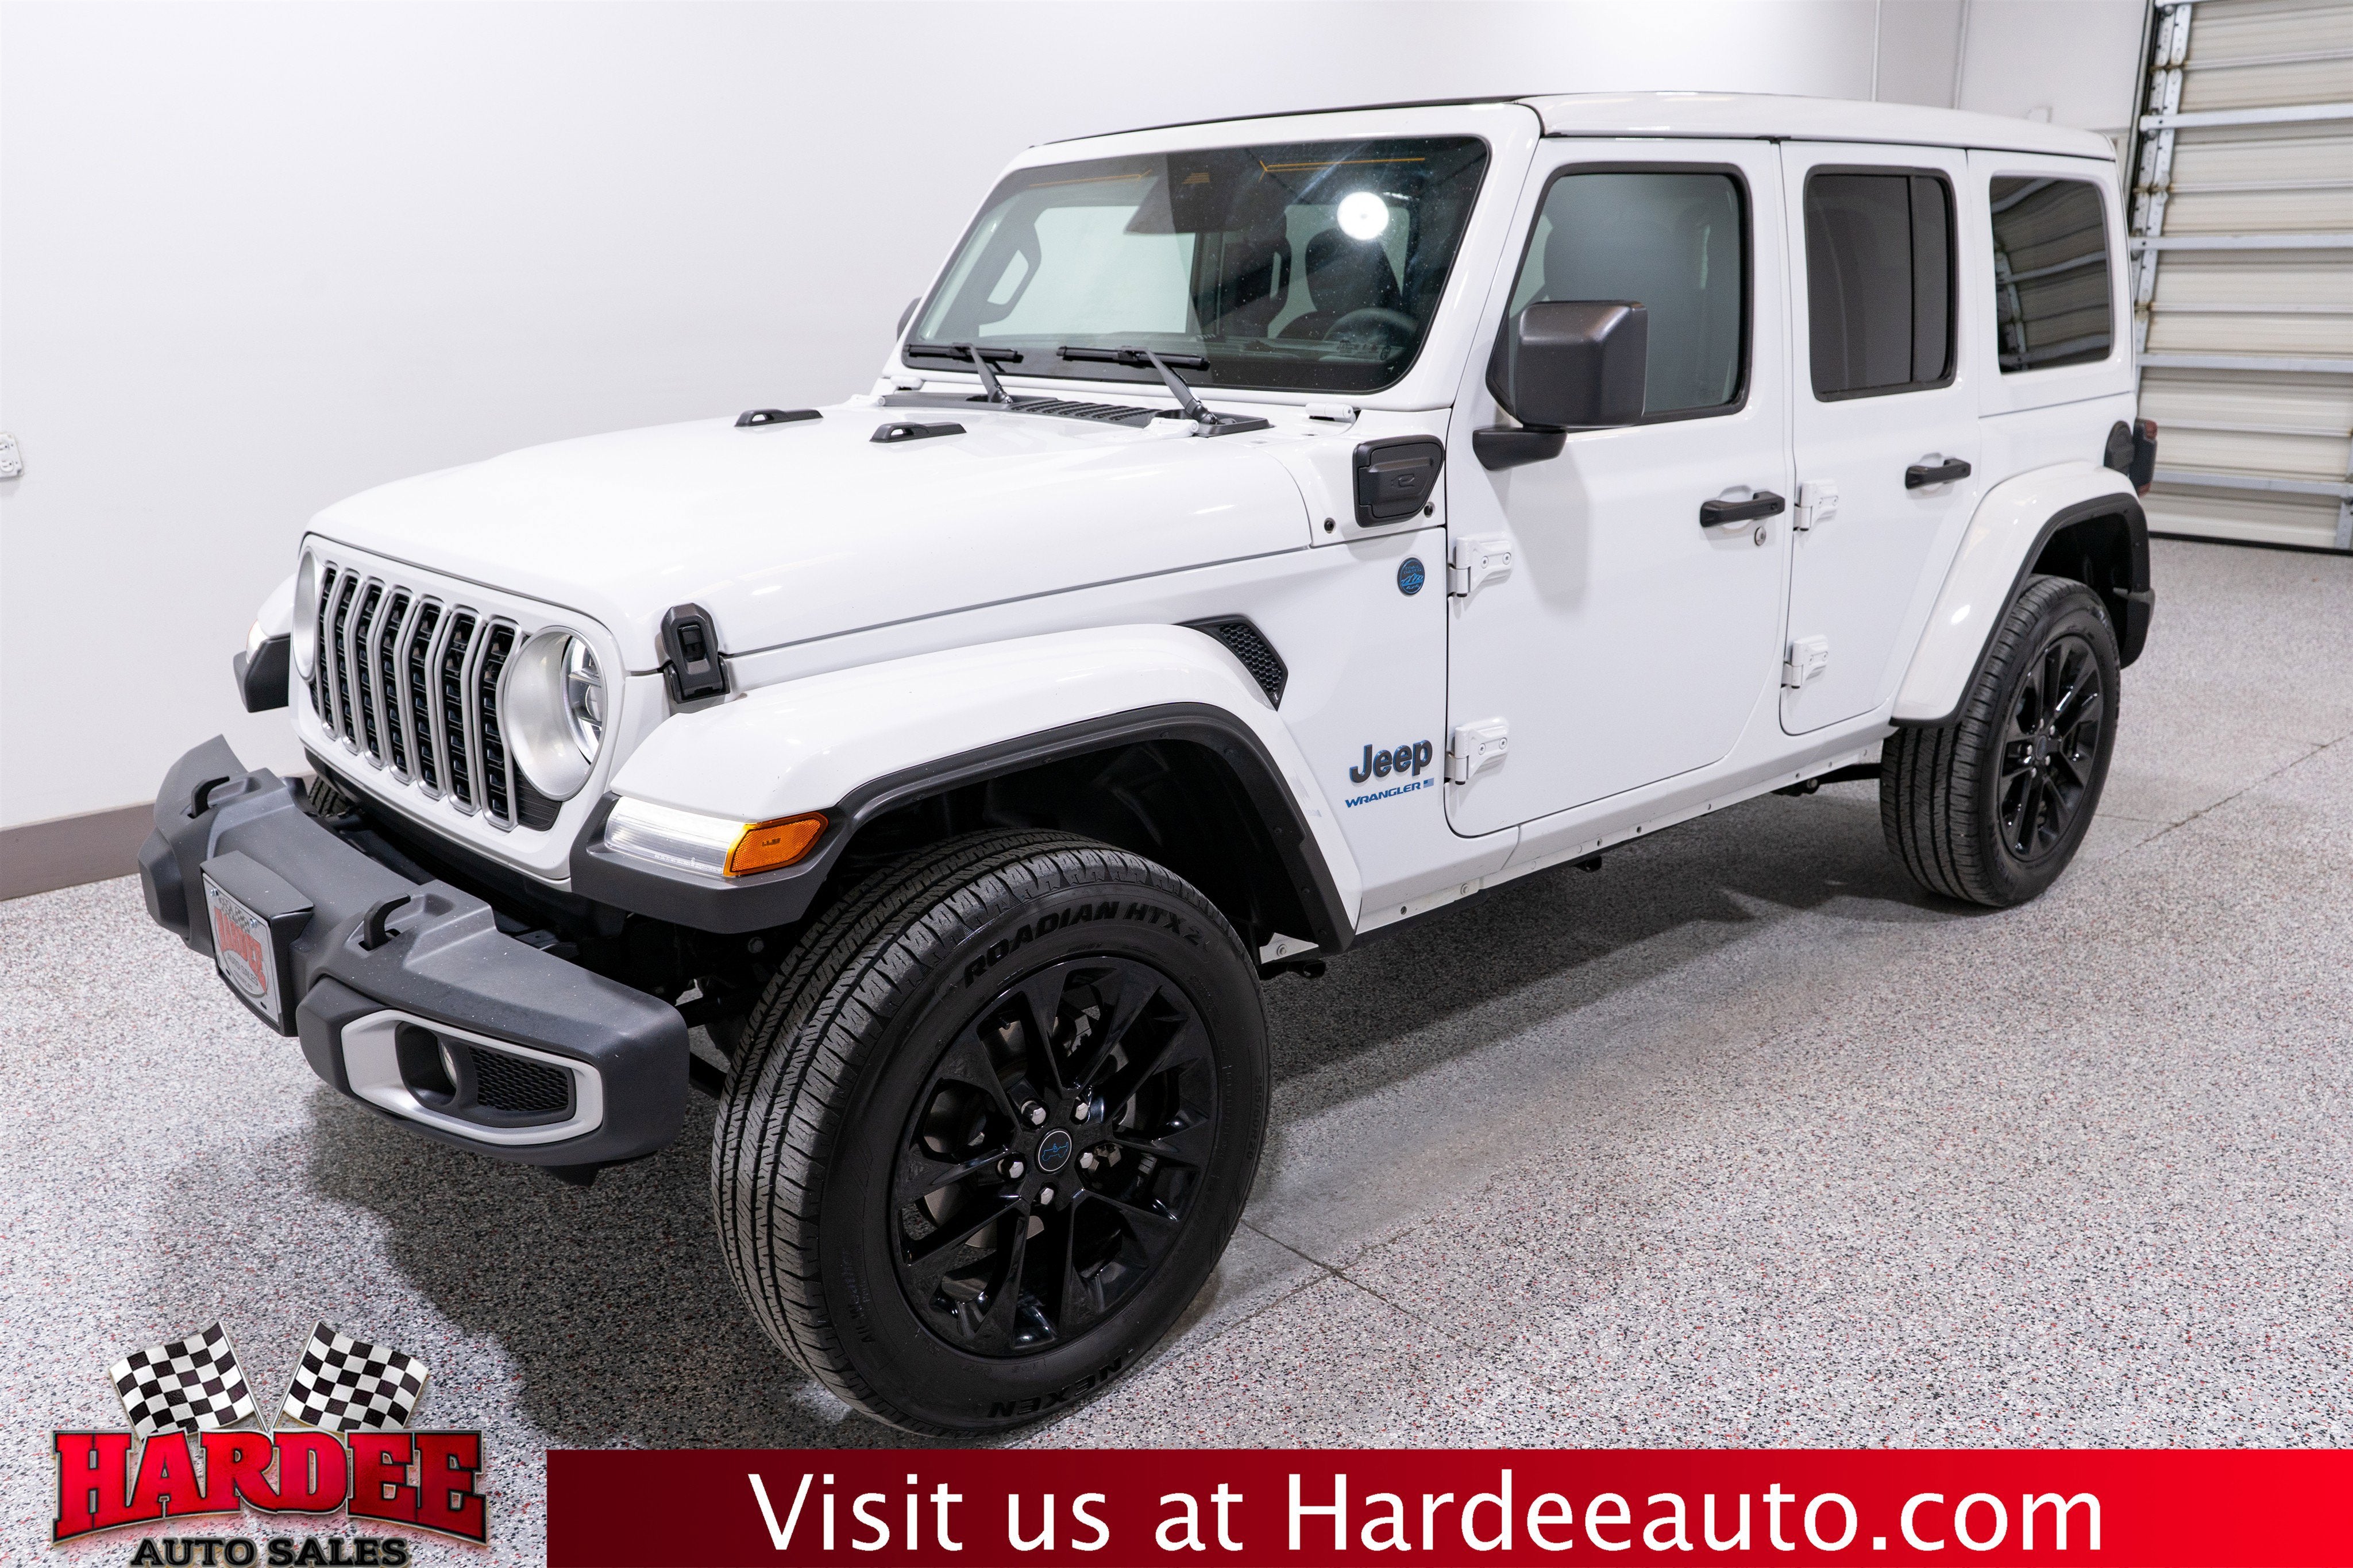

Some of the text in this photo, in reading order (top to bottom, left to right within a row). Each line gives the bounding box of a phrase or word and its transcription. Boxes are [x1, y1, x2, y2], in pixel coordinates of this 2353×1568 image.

[1349, 740, 1433, 783] Jeep
[1345, 782, 1421, 808] WRANGLER
[965, 901, 1120, 989] ROADIAN
[987, 1356, 1121, 1418] NEXEN
